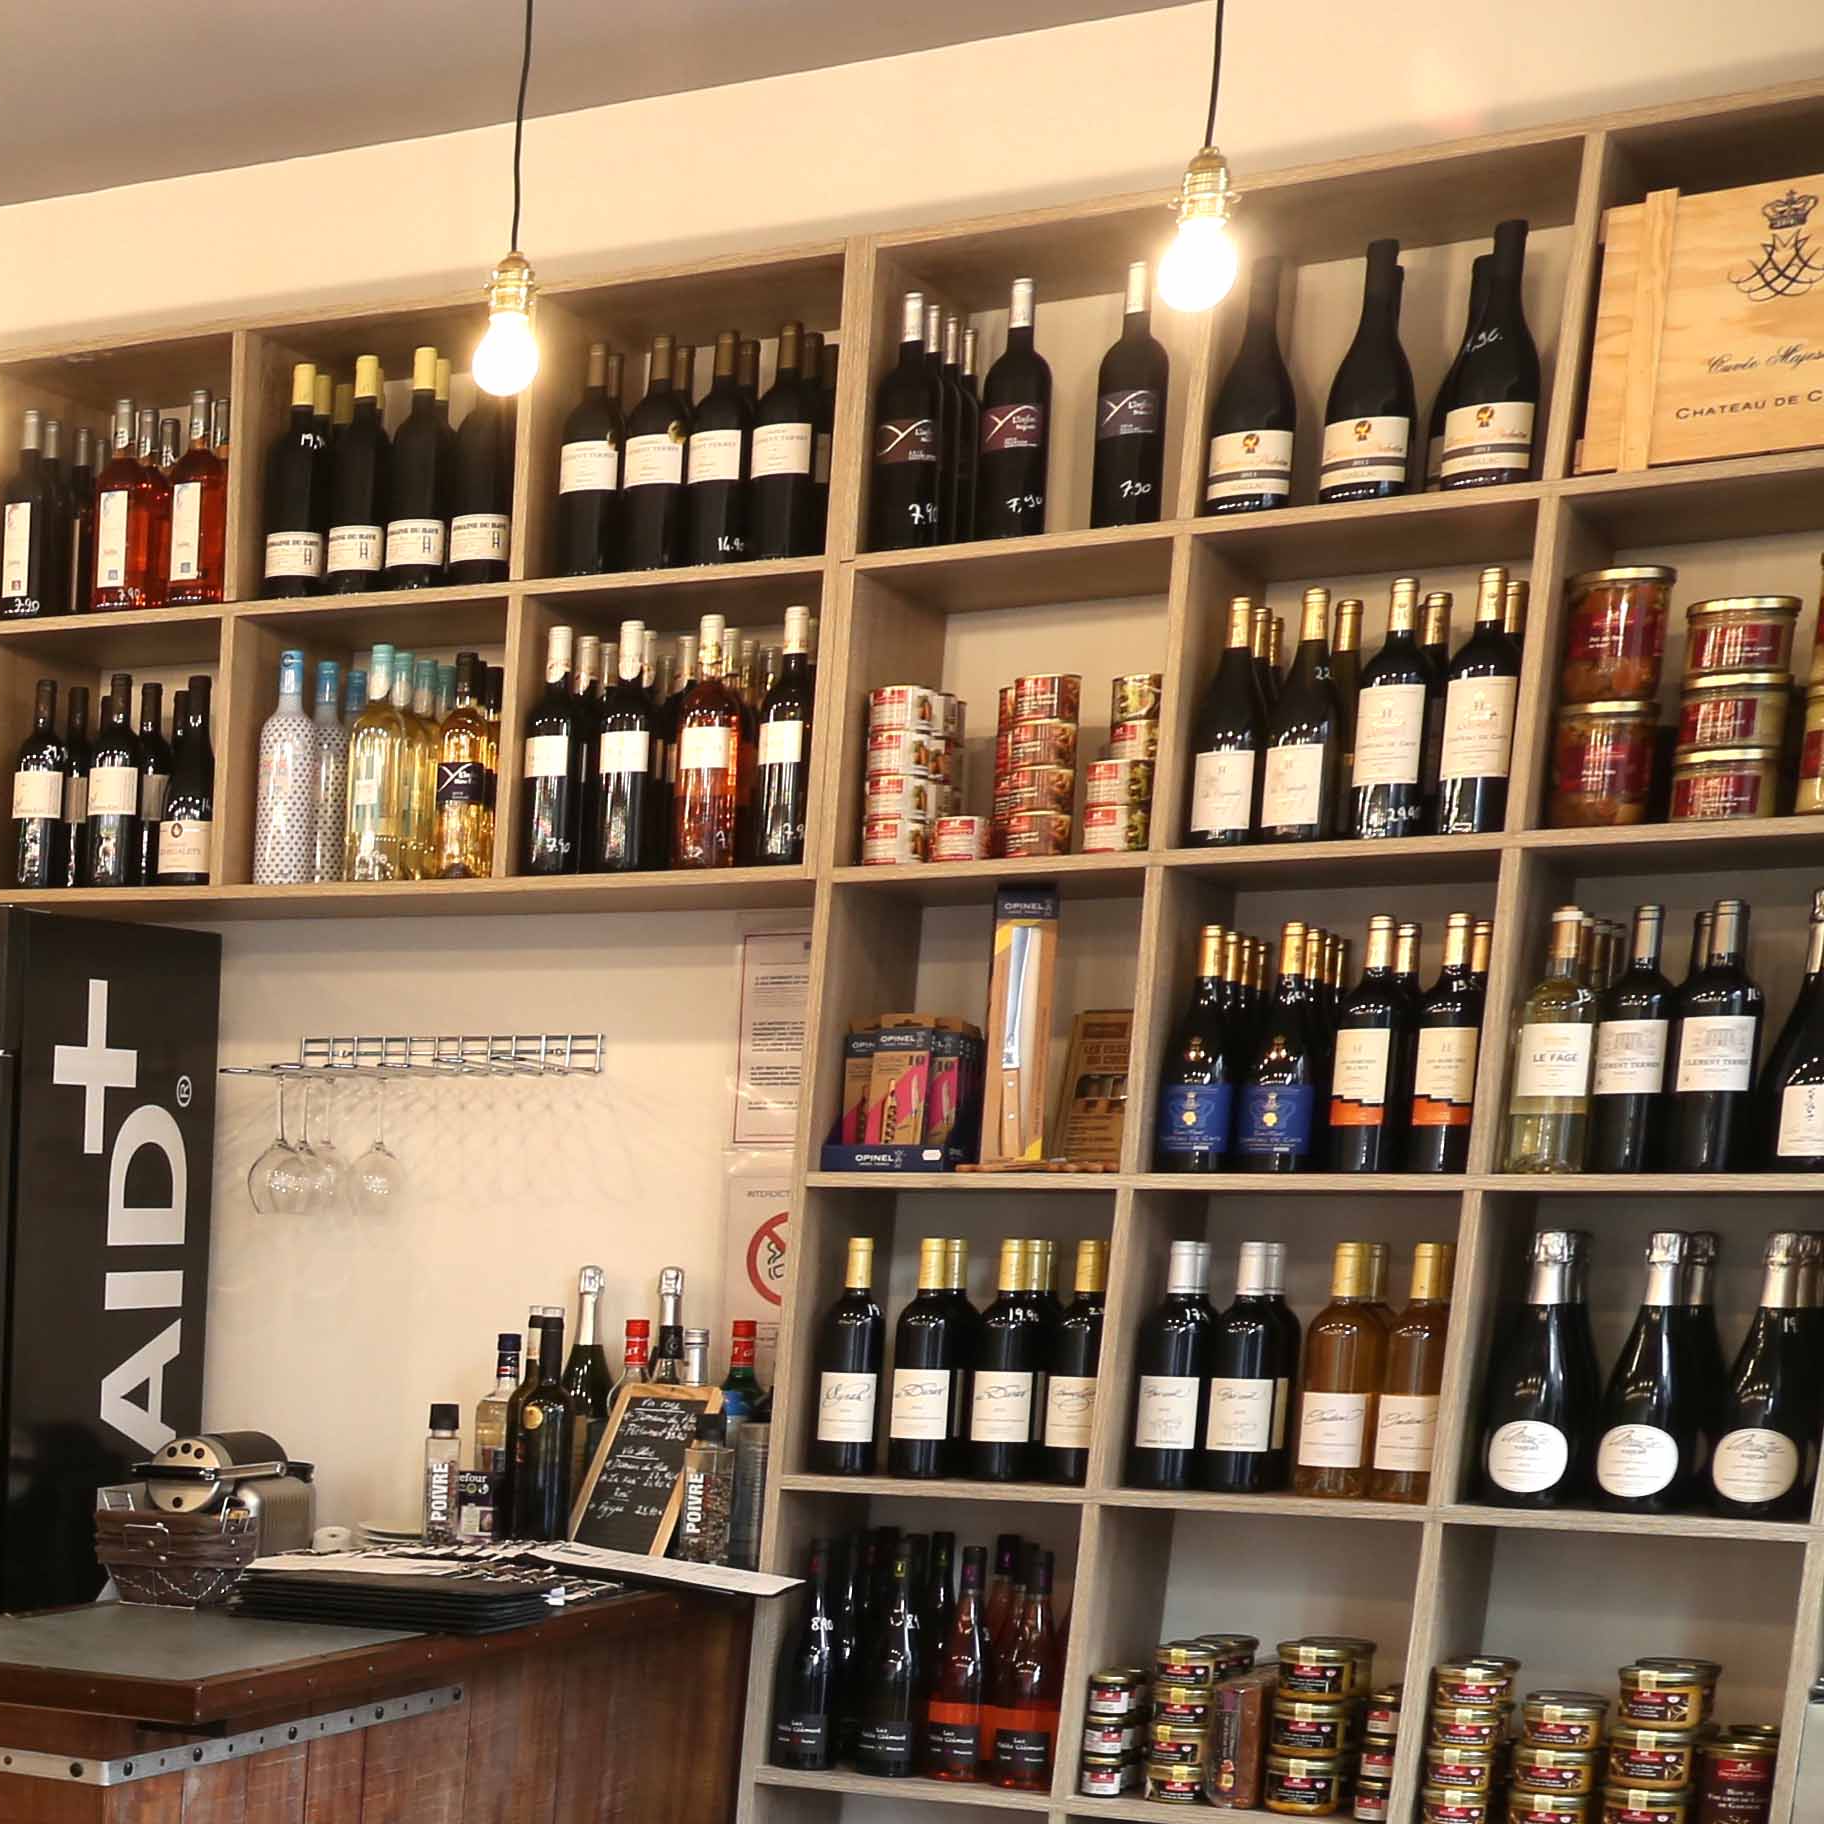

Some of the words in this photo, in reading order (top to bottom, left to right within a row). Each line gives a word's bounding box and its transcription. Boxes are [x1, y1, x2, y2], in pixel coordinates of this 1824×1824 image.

[1675, 400, 1767, 421] CHATEAU
[1774, 394, 1799, 408] DE
[1004, 902, 1044, 911] OPINEL
[880, 1034, 915, 1043] OPINEL
[852, 1041, 875, 1049] OPIN
[855, 1153, 894, 1162] OPINEL
[430, 1462, 450, 1522] POIVRE
[686, 1472, 704, 1534] POIVRE
